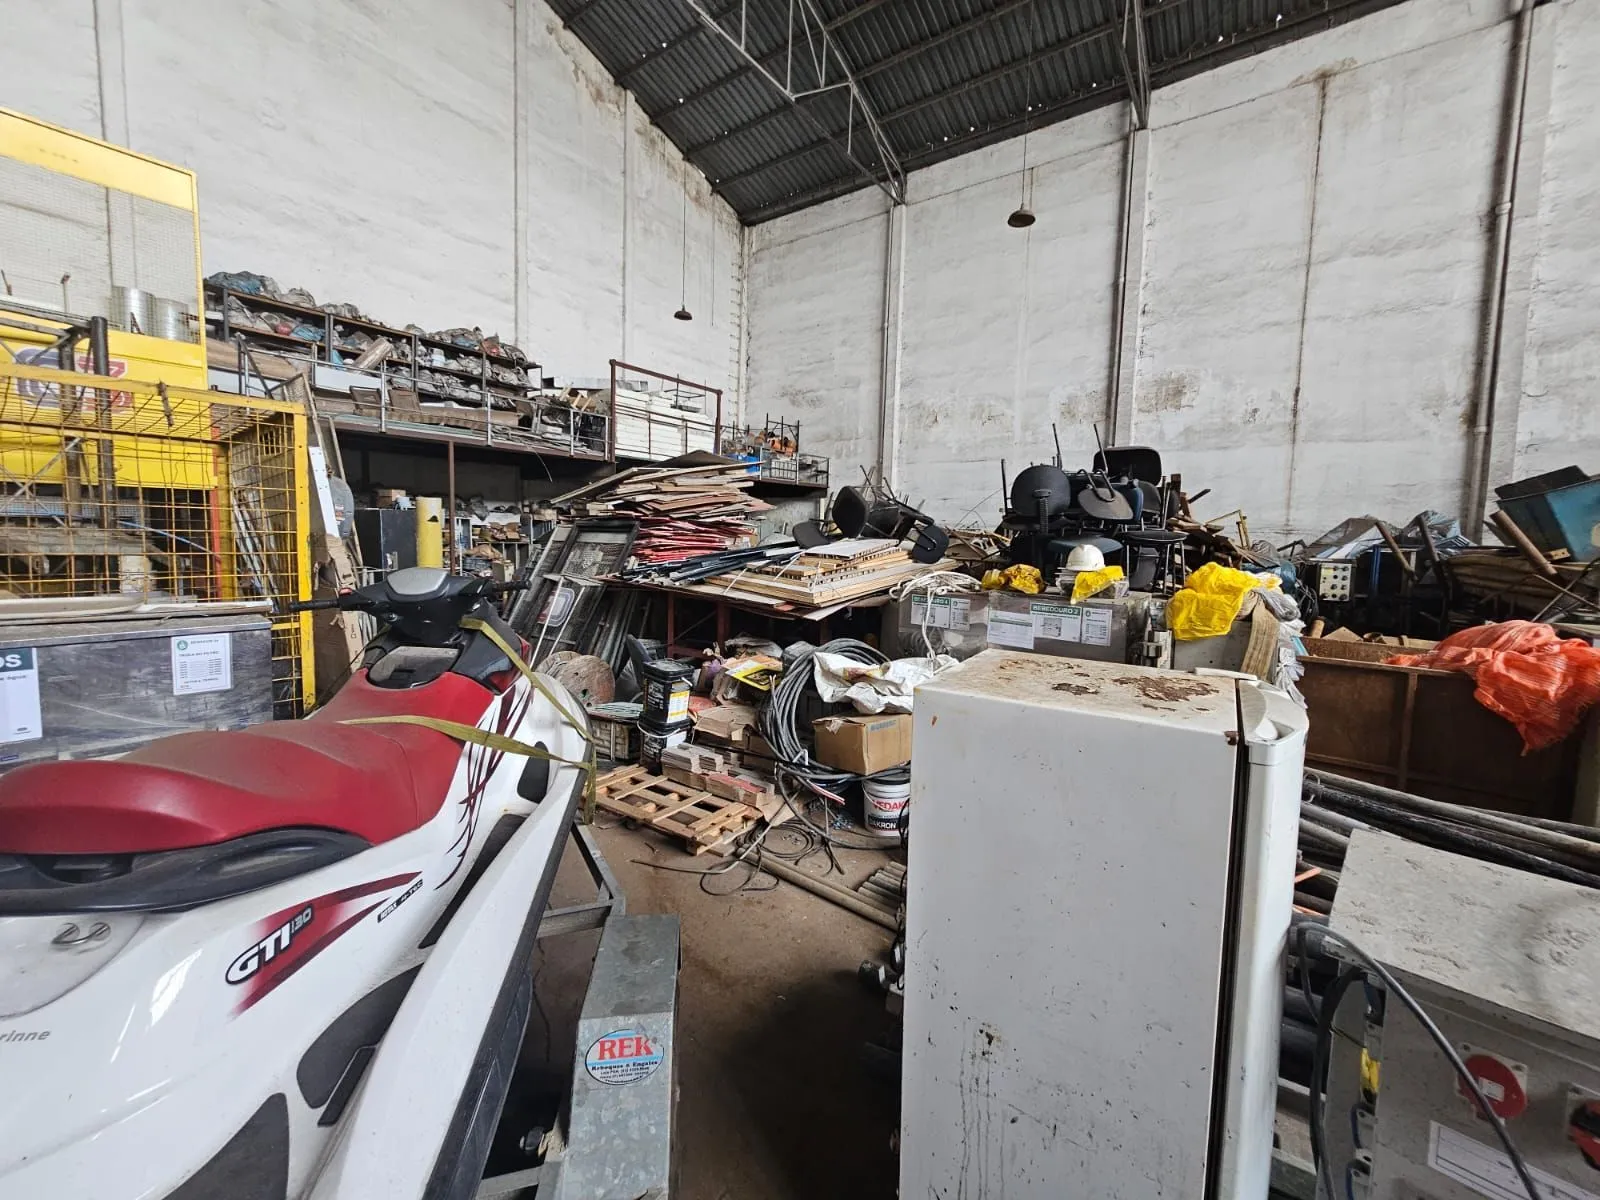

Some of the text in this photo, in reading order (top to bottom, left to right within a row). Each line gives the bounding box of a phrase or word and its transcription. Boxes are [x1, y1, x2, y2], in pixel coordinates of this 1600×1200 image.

[227, 907, 312, 982] GTI 130
[598, 1037, 653, 1060] REK
